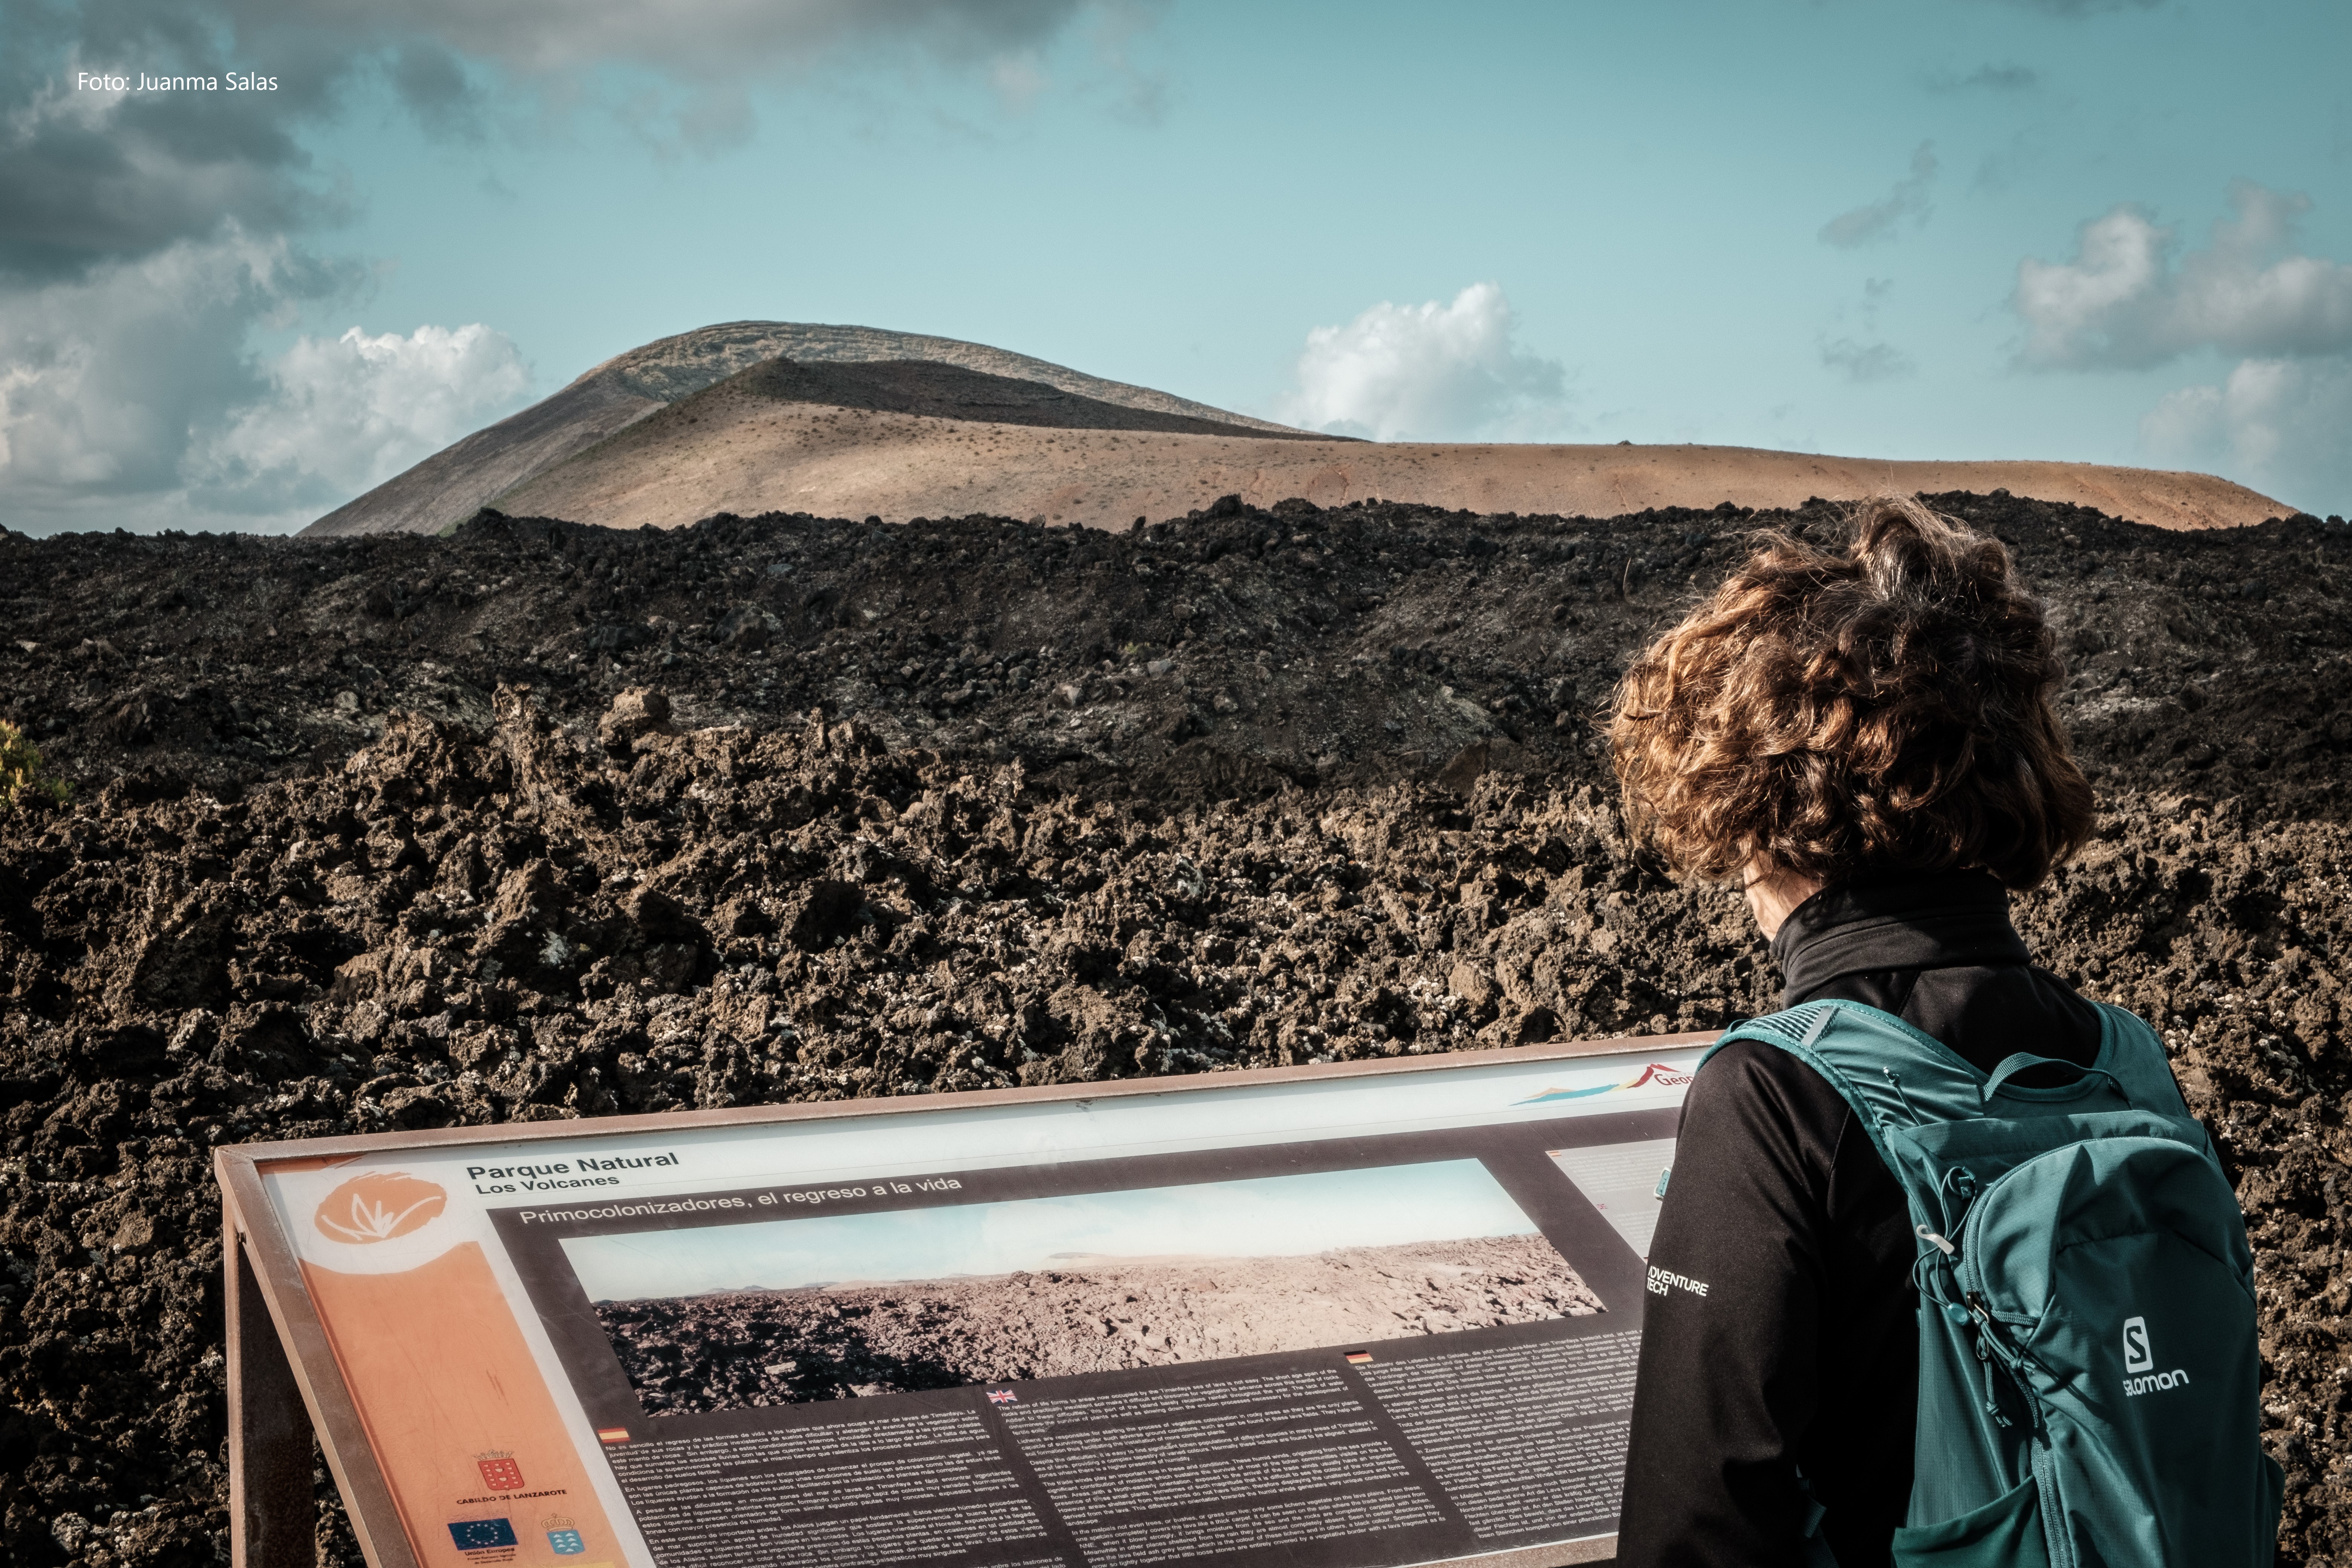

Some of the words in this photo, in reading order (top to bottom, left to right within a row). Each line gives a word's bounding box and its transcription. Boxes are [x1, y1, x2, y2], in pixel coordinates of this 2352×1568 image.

[466, 1163, 570, 1180] Parque
[576, 1152, 679, 1172] Natural
[475, 1183, 516, 1194] Los
[520, 1175, 620, 1190] Volcanes
[519, 1197, 752, 1224] Primocolonizadores,
[758, 1192, 778, 1205] el
[783, 1186, 867, 1204] regreso
[872, 1184, 887, 1195] a
[889, 1182, 912, 1194] la
[916, 1178, 962, 1191] vida
[1647, 1277, 1669, 1296] TECH
[2122, 1369, 2189, 1396] salomon
[456, 1496, 496, 1504] CABILDO
[513, 1489, 567, 1499] LANZAROTE
